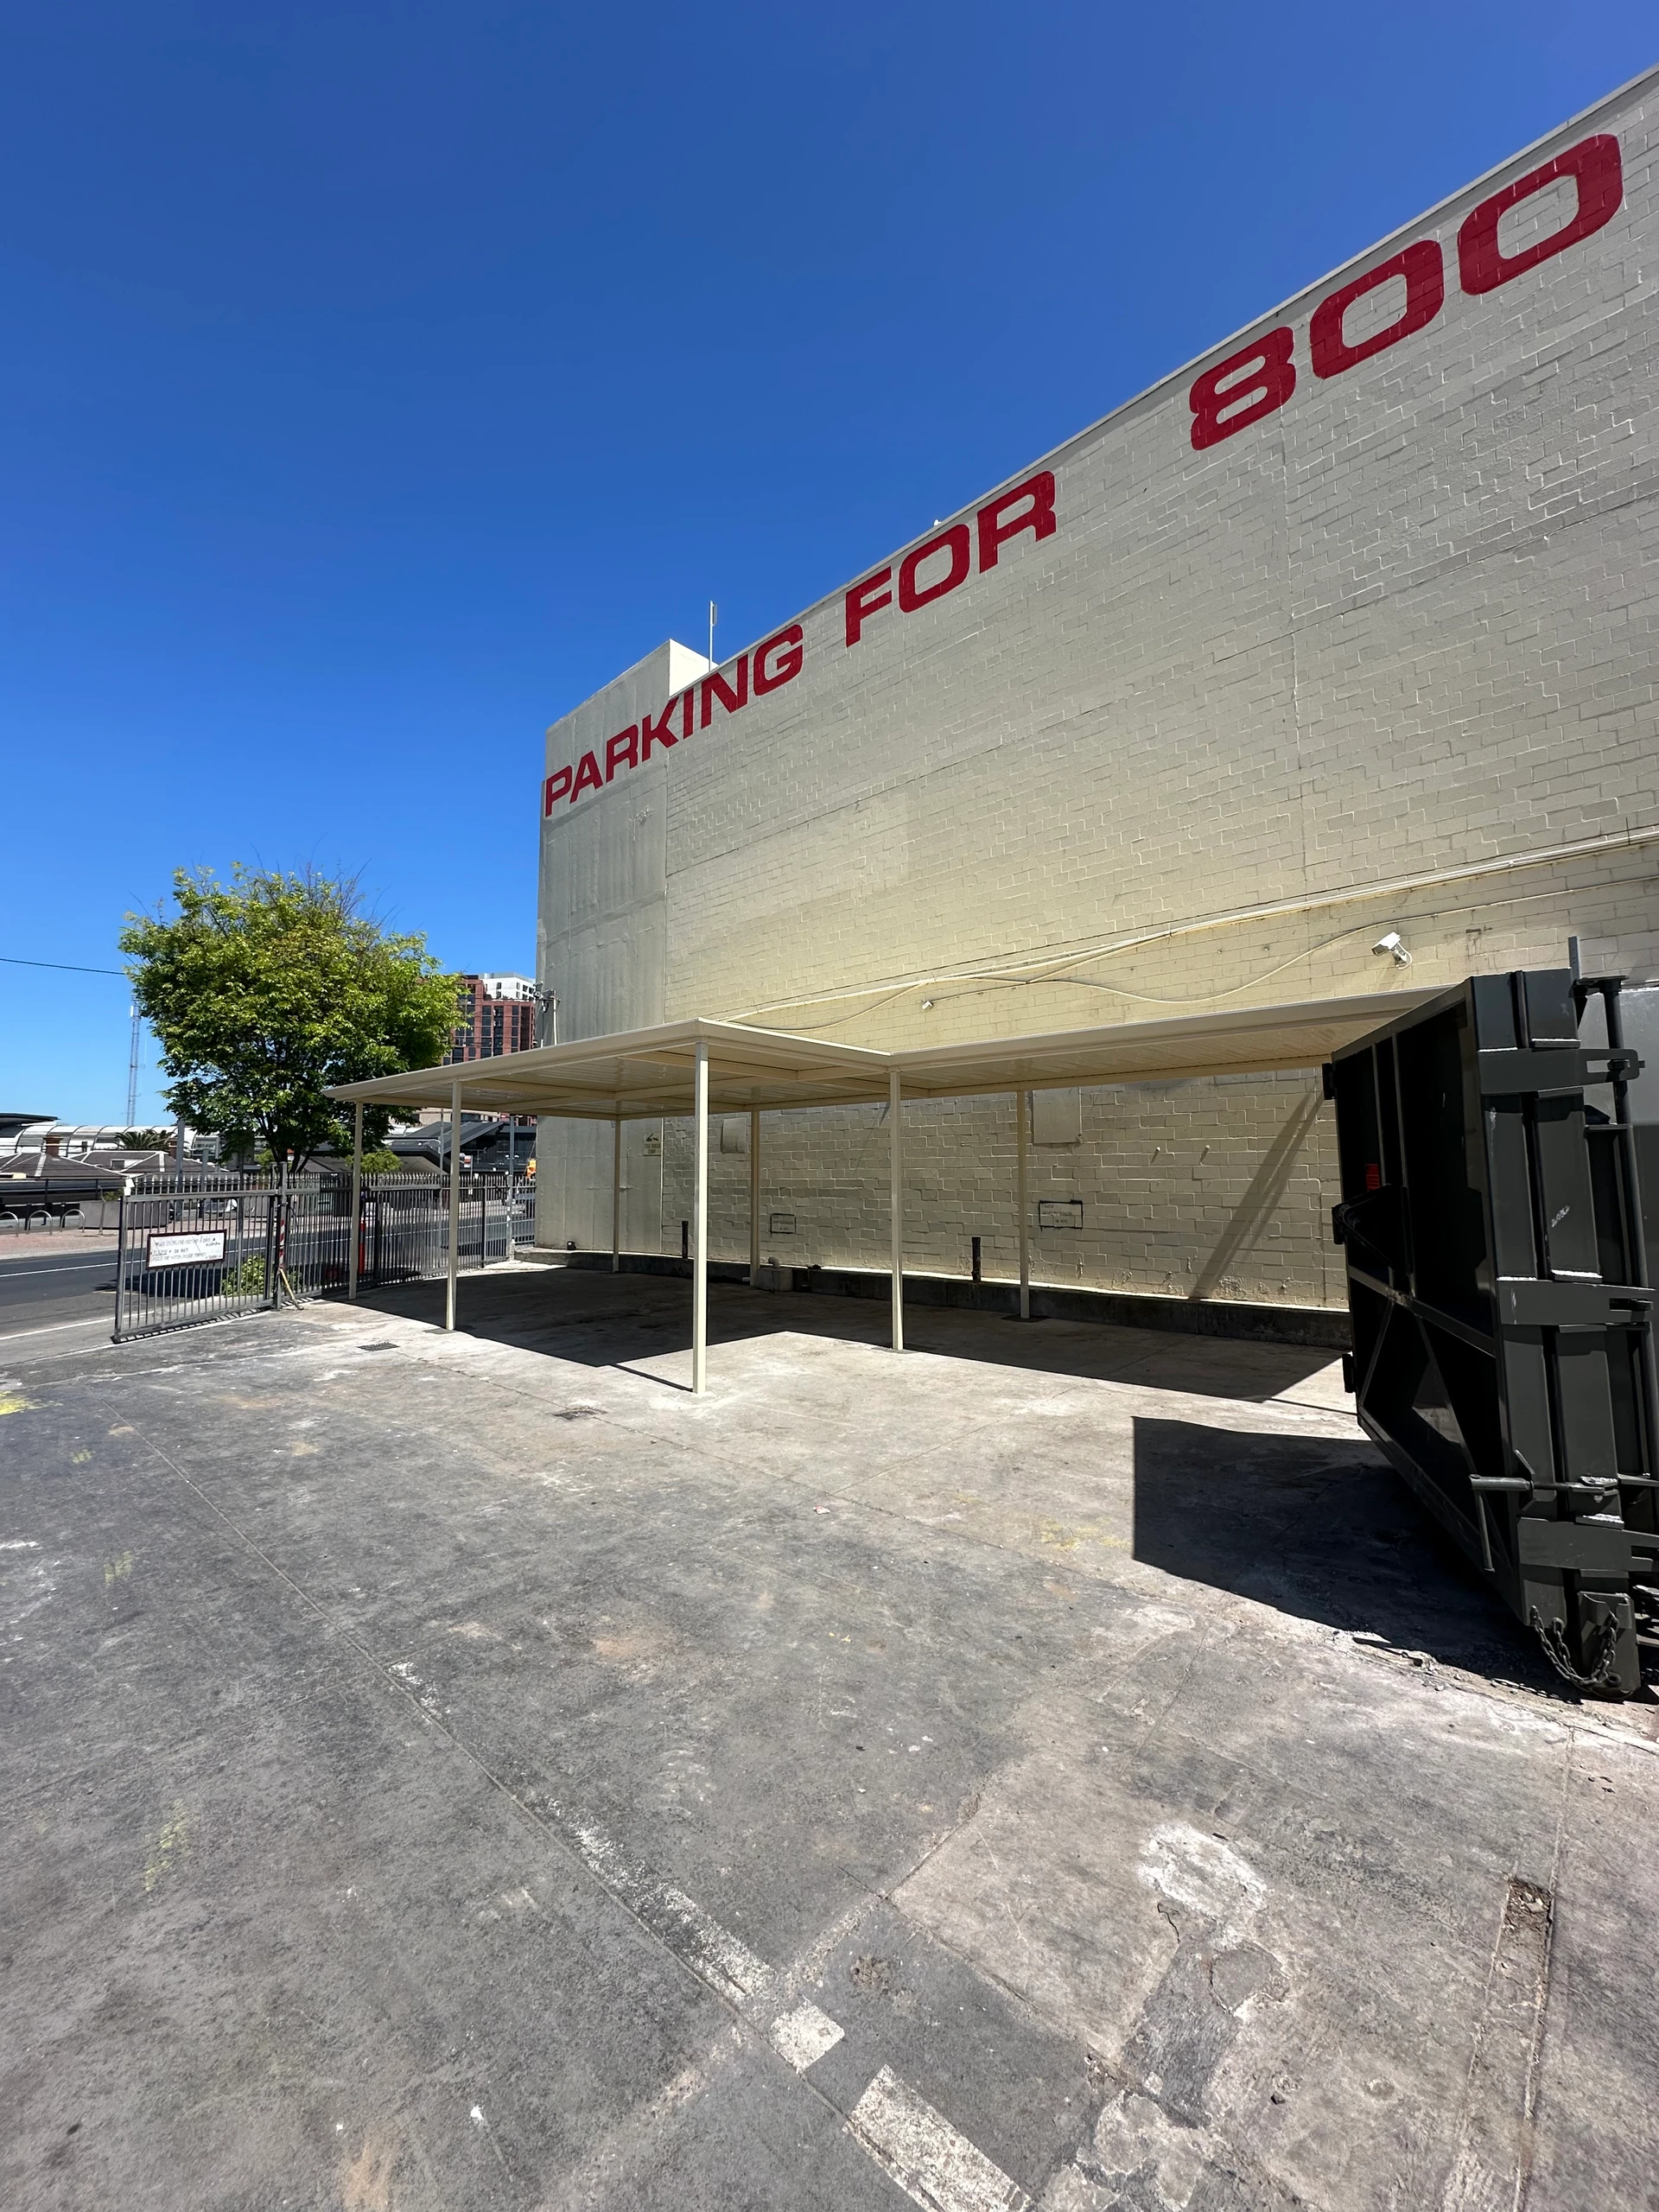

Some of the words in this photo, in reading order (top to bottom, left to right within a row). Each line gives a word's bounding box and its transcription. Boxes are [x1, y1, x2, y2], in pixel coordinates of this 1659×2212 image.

[545, 624, 804, 817] PARKING
[845, 470, 1057, 648] FOR
[1189, 133, 1624, 451] 800
